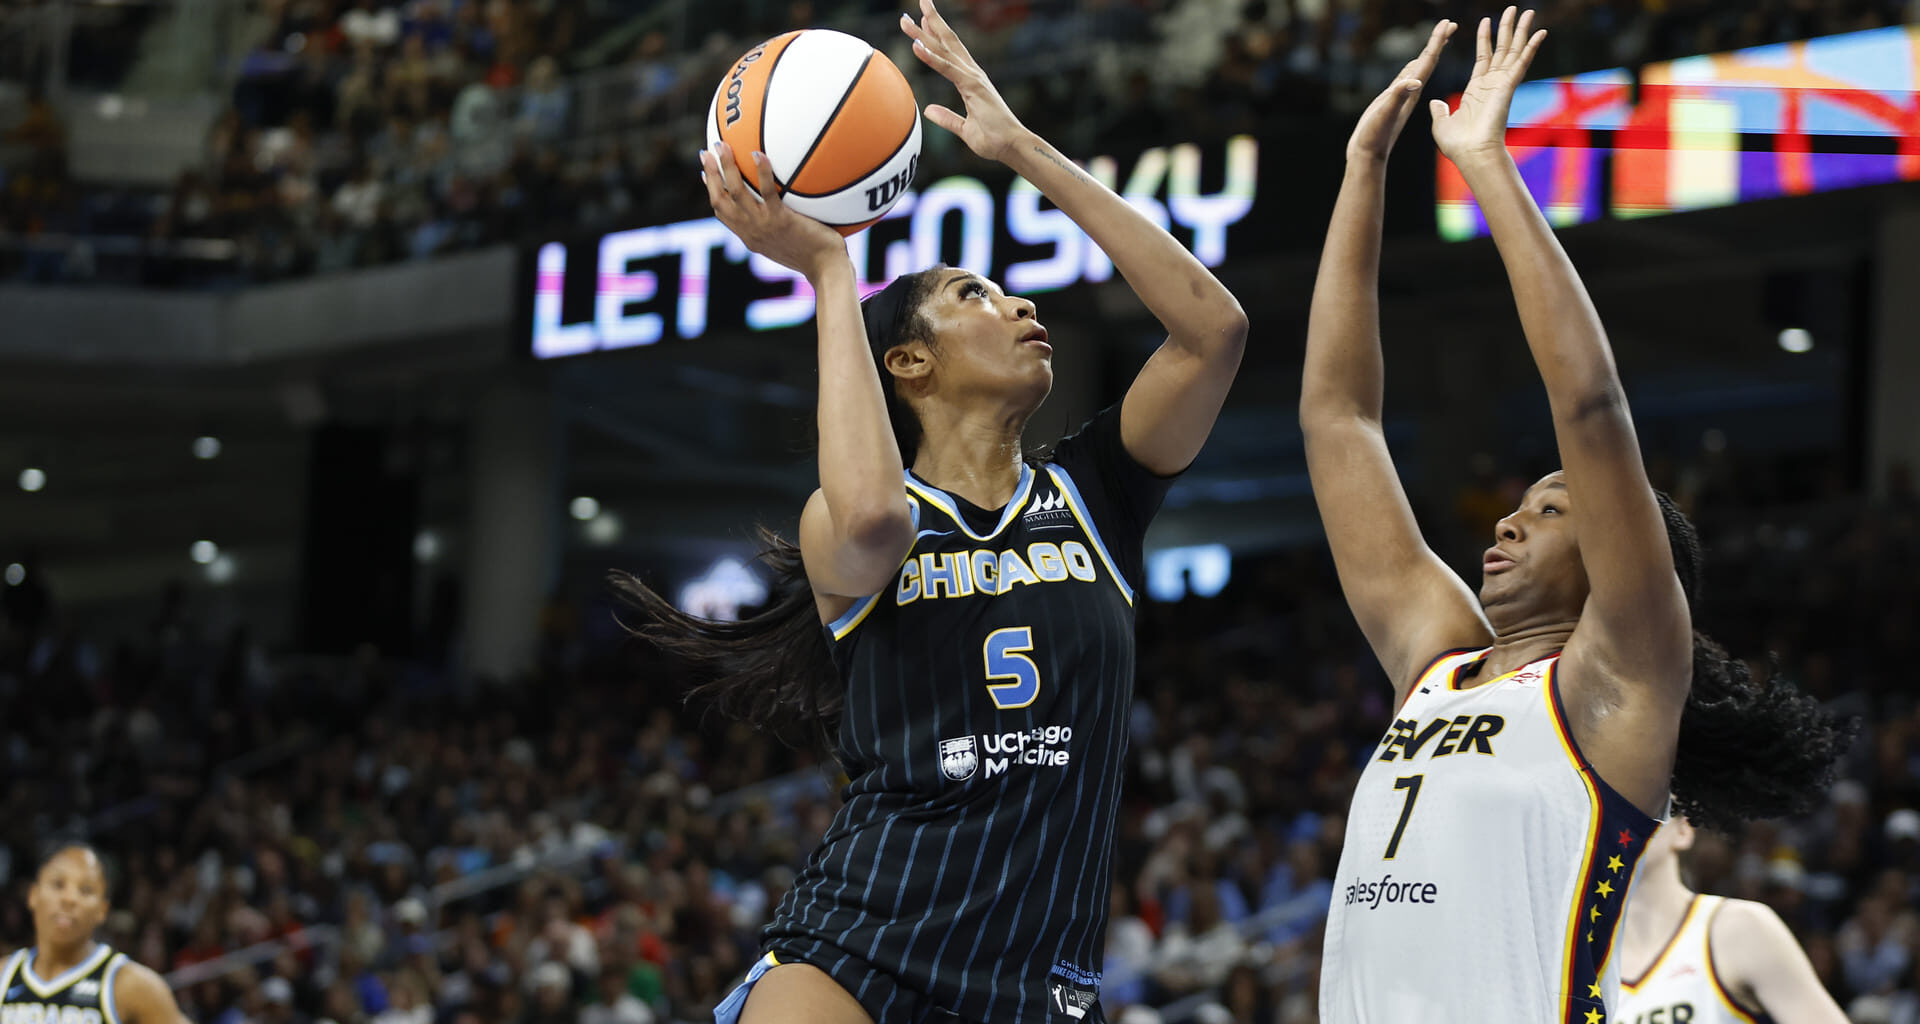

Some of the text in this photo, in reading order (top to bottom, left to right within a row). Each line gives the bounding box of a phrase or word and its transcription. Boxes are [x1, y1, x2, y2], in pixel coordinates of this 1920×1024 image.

[865, 153, 920, 212] Wil
[897, 541, 1096, 606] CHICAGO
[983, 626, 1040, 709] 5
[1382, 774, 1425, 861] 7
